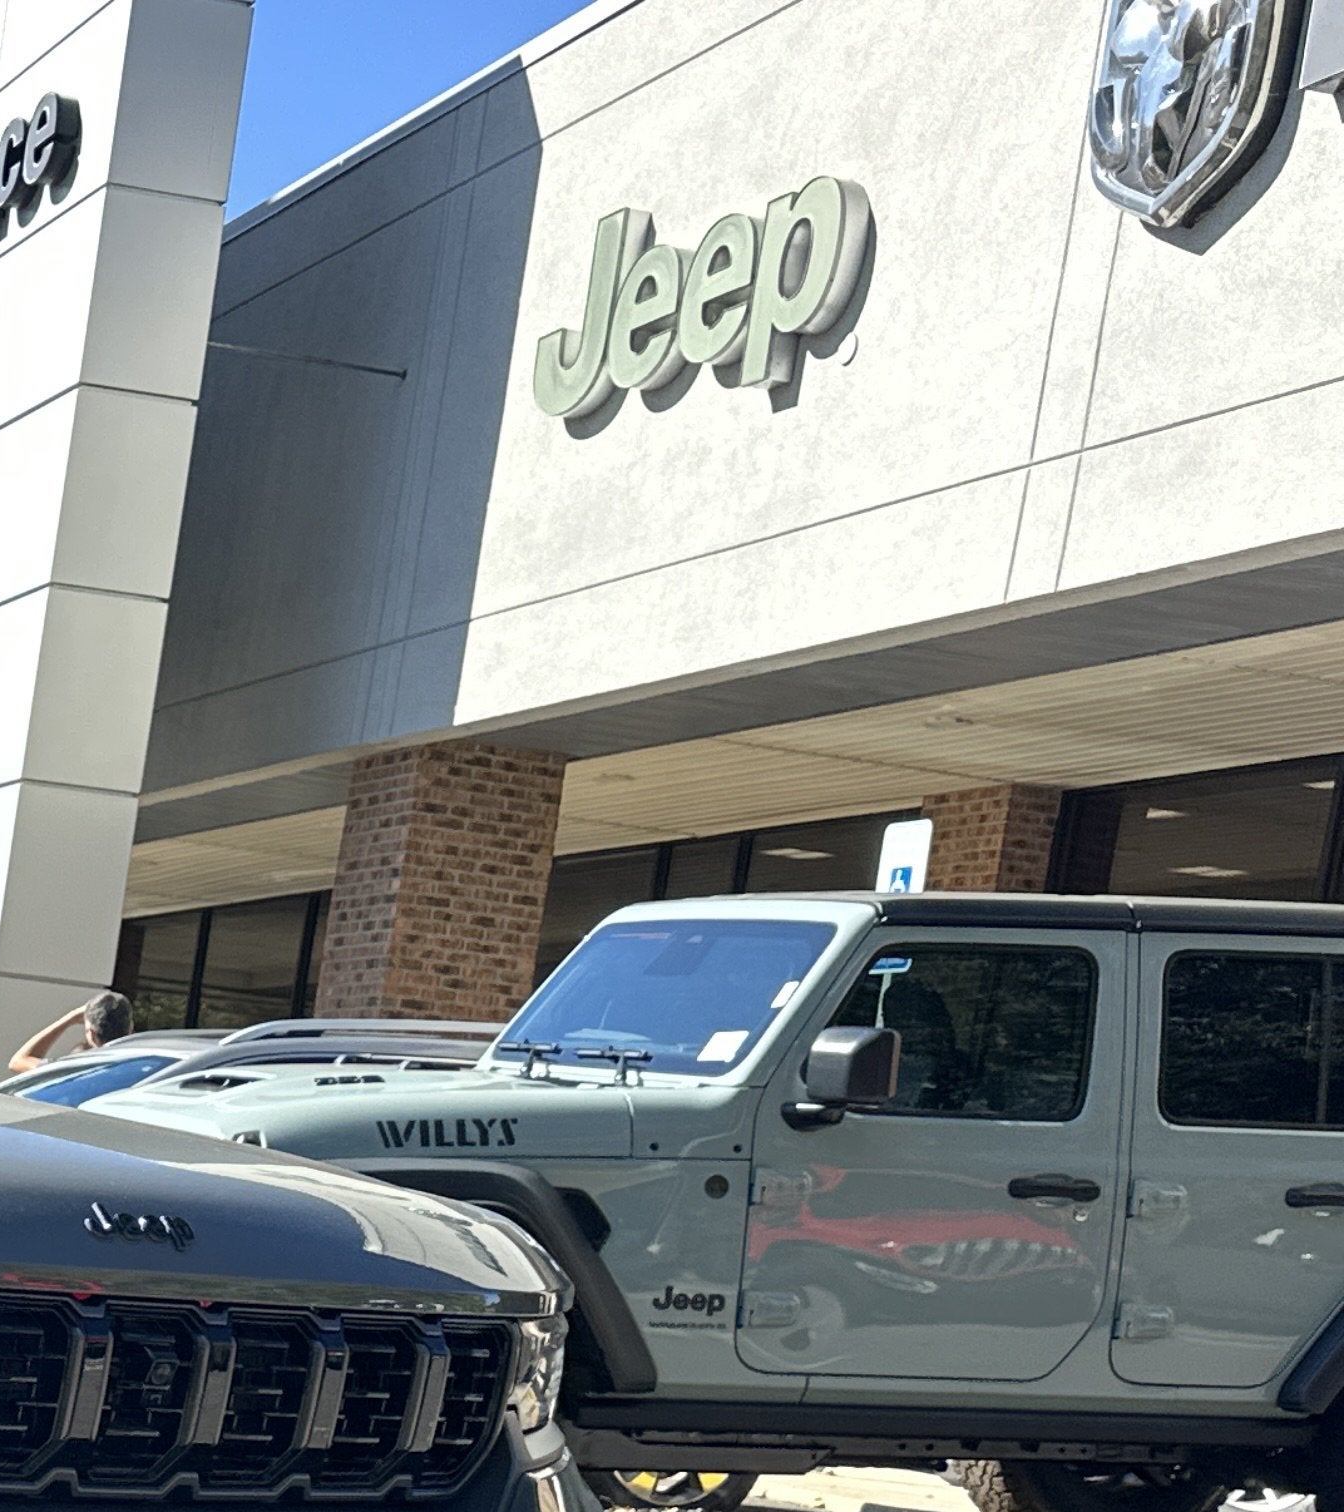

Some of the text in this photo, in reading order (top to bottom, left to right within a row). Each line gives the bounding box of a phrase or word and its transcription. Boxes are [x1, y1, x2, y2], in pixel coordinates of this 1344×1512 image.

[533, 175, 869, 417] Jeep
[376, 1118, 519, 1148] WILLYS
[83, 1201, 195, 1252] Jeep
[652, 1285, 725, 1316] Jeep
